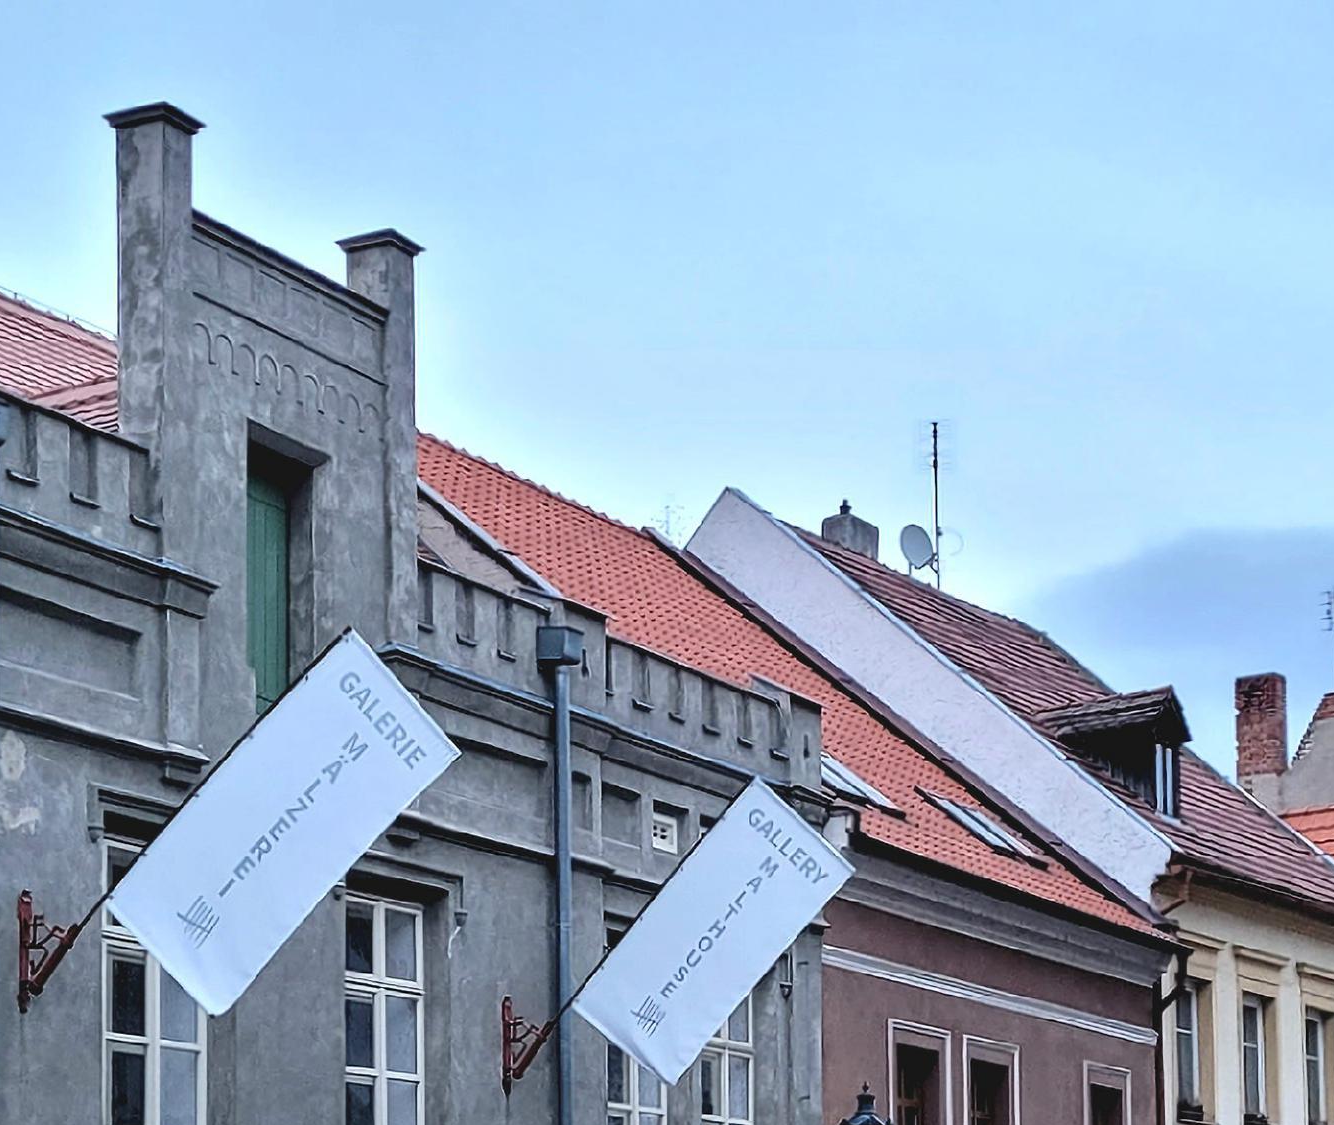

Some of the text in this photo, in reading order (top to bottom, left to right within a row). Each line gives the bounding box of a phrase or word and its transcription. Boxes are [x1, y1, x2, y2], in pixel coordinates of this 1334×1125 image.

[338, 671, 427, 770] GALERIE
[219, 732, 368, 897] MÄLZEREI
[748, 808, 829, 885] GALLERY
[661, 856, 779, 999] MALTHOUSE
